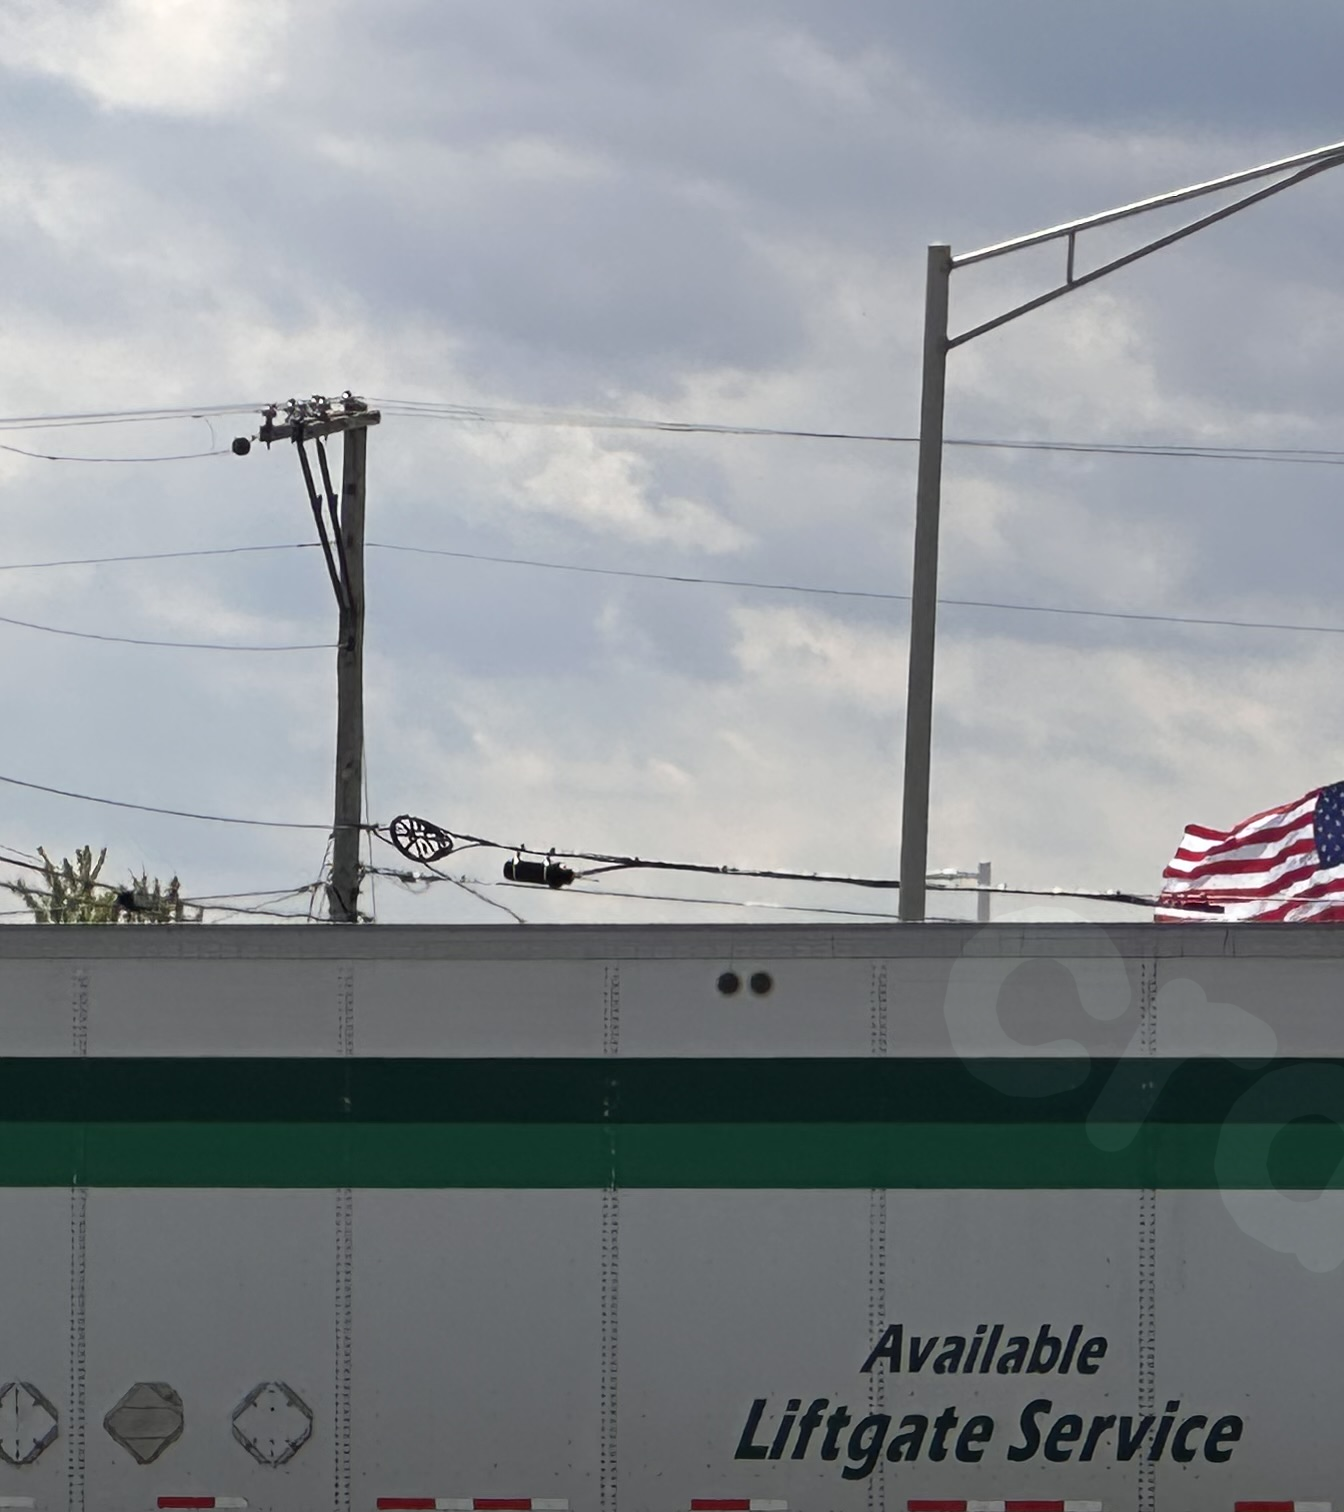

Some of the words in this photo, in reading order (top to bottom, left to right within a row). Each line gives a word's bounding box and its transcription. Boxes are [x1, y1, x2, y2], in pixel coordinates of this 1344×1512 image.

[859, 1323, 1109, 1375] Available
[733, 1398, 994, 1480] Liftgate
[1006, 1399, 1243, 1464] Service
